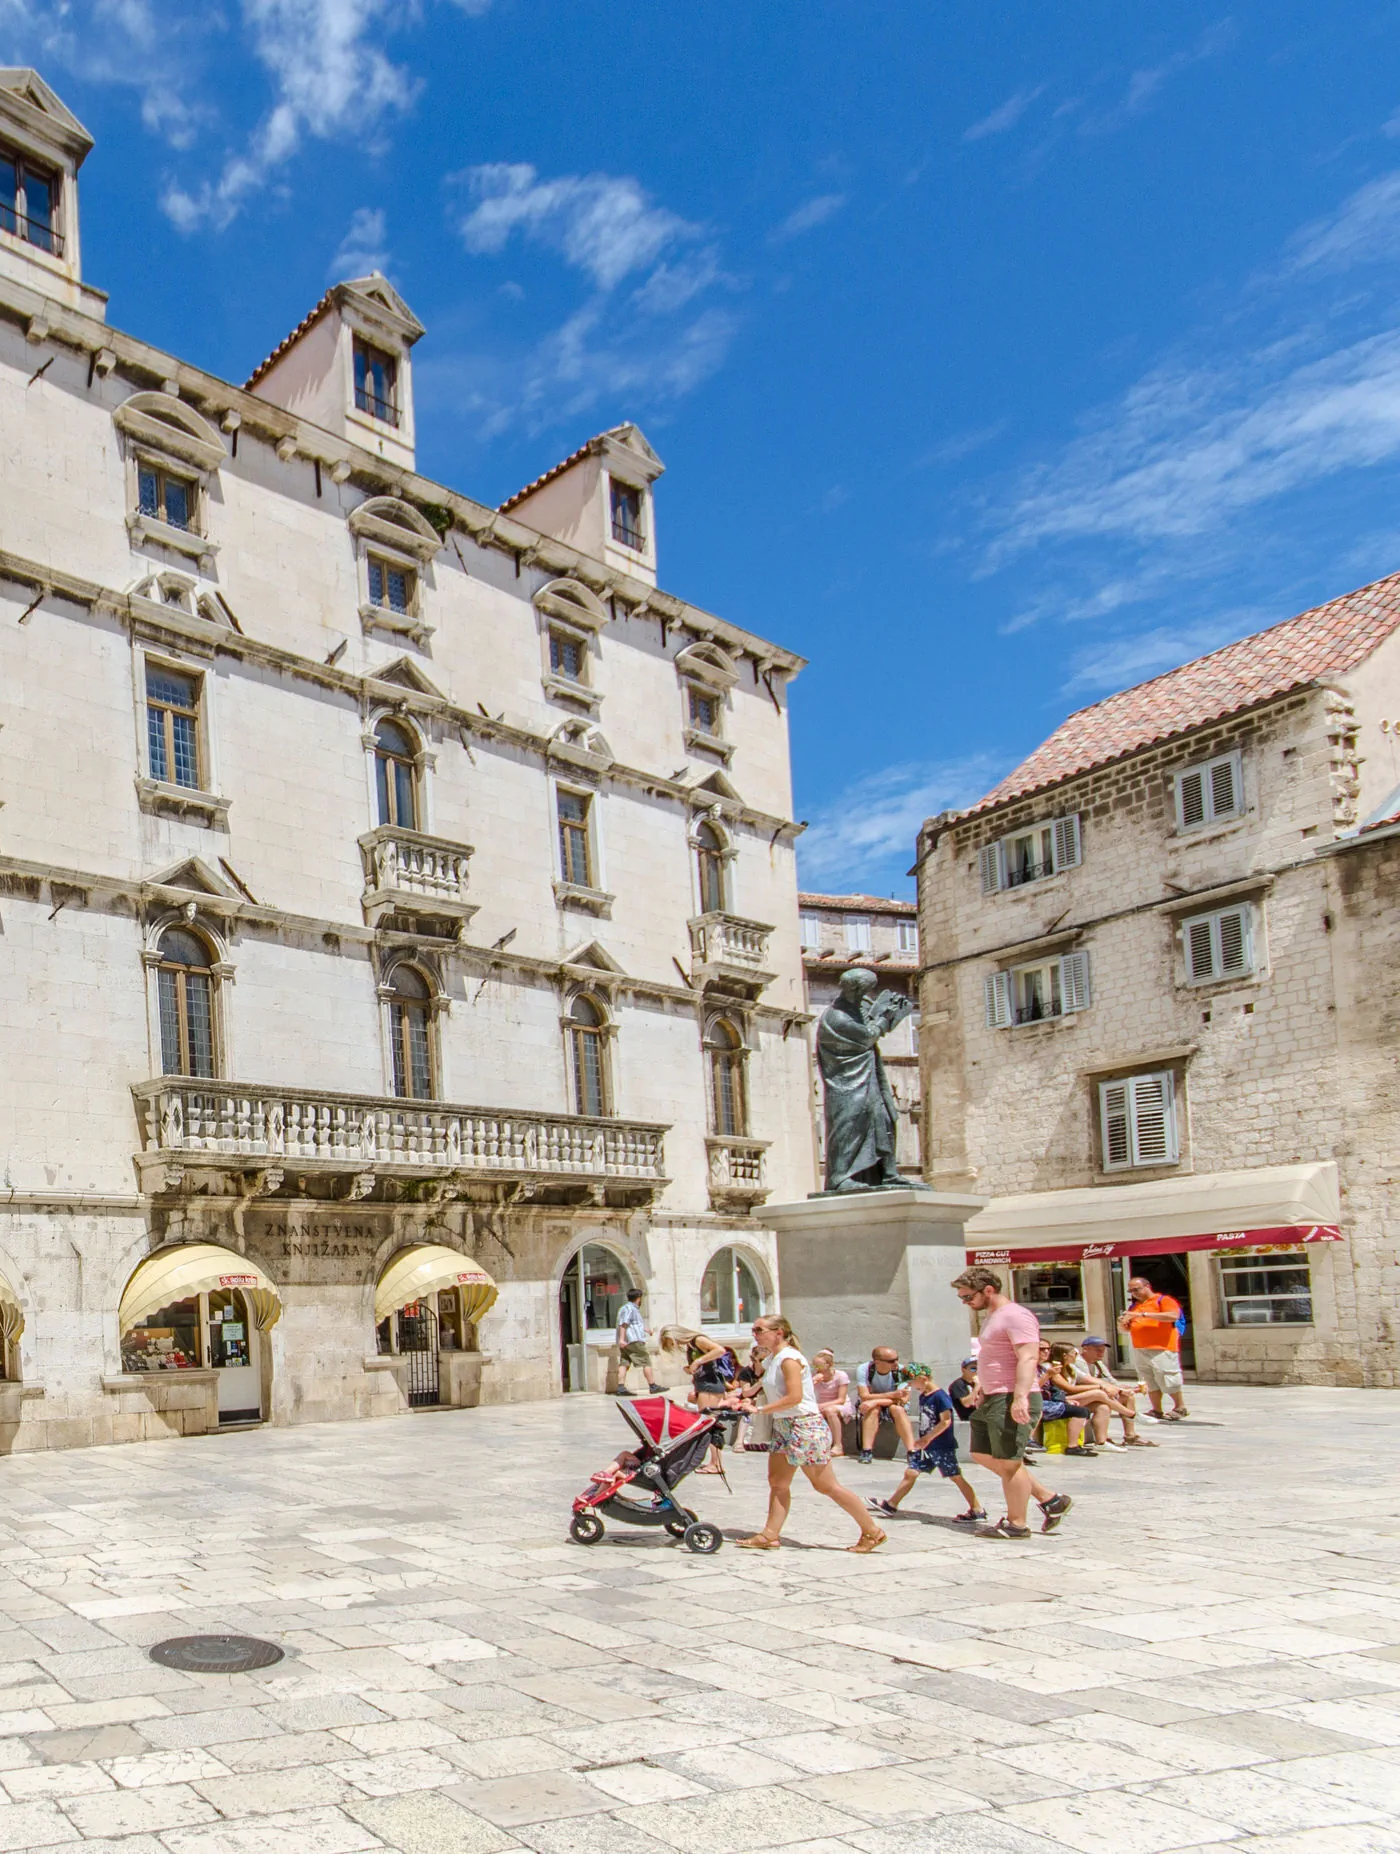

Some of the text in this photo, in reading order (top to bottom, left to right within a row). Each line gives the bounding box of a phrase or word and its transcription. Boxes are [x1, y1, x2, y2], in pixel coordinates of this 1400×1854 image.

[264, 1223, 375, 1238] ZNANSTVENA
[1216, 1232, 1246, 1241] PASTA
[282, 1240, 361, 1256] KNJIŽARA
[974, 1257, 1012, 1265] SANDWICH
